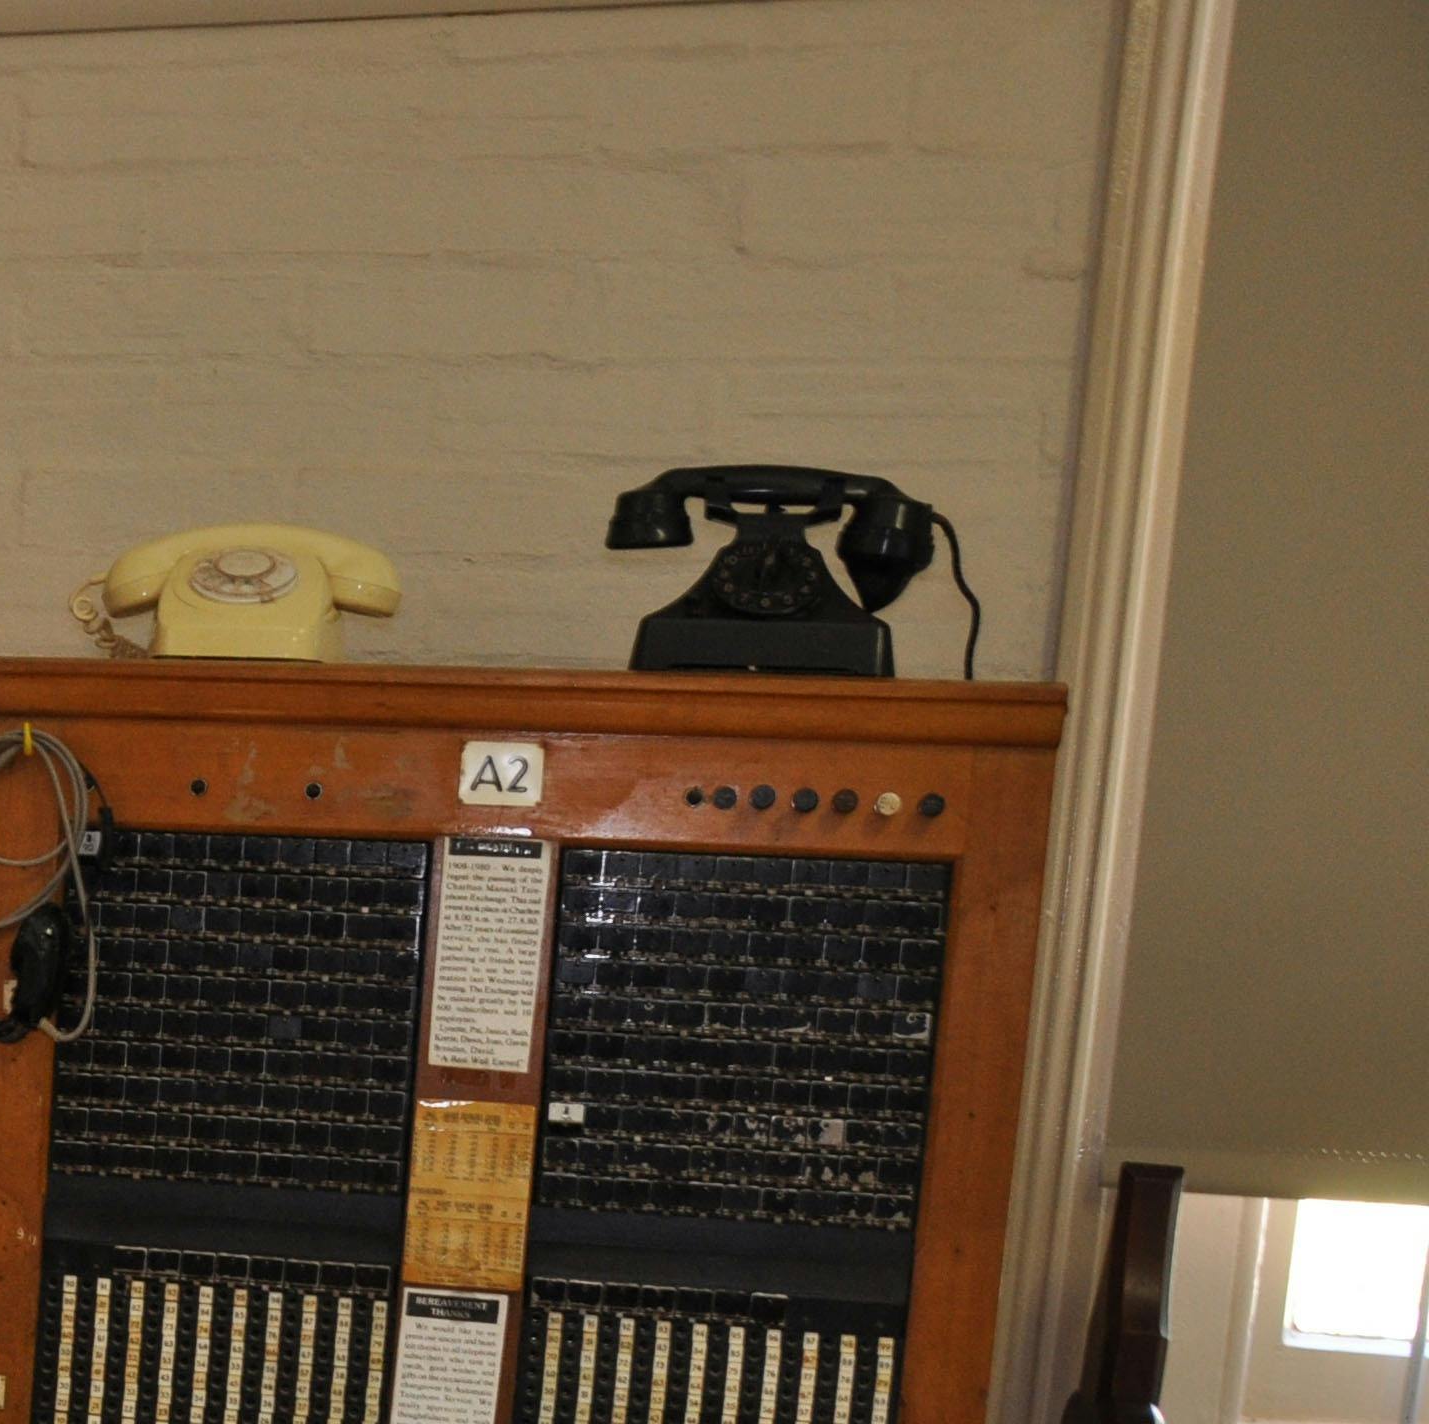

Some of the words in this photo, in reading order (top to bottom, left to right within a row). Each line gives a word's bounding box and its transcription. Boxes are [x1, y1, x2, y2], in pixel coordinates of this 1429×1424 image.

[470, 755, 528, 792] A2
[415, 1296, 488, 1310] BEREAVEMENT
[431, 1308, 471, 1318] THANKS
